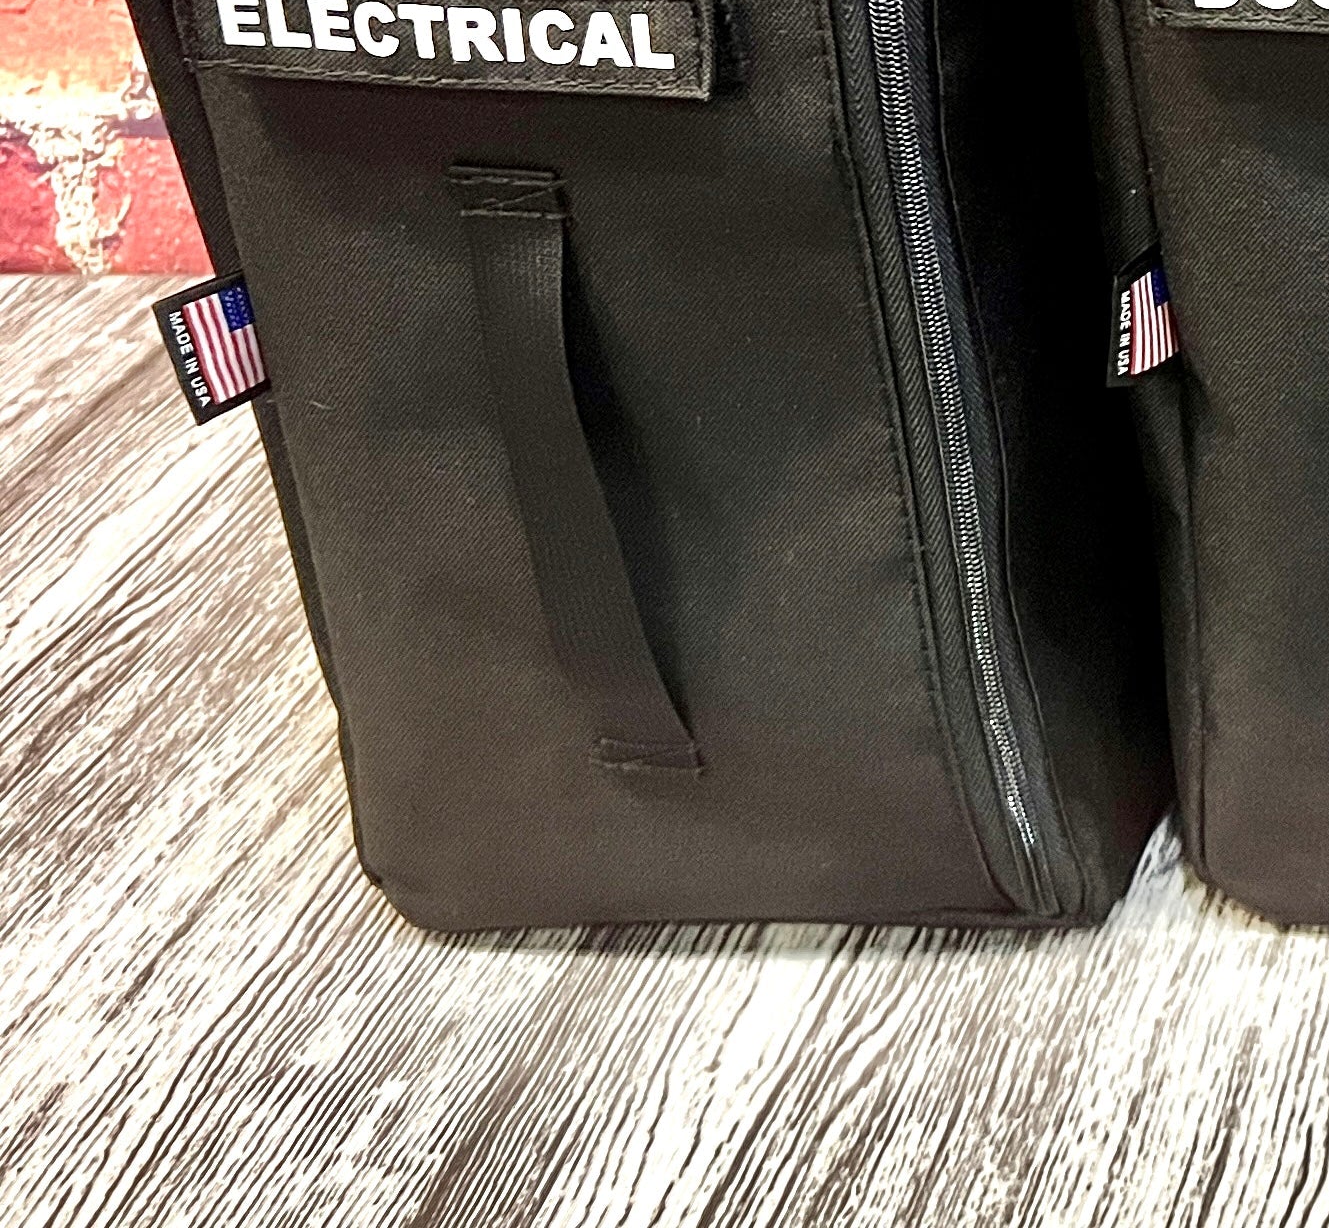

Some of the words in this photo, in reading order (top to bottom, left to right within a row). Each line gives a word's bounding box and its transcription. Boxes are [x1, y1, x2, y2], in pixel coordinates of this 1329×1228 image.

[1119, 289, 1132, 331] MADE
[168, 310, 194, 356] MADE
[1119, 332, 1131, 348] IN
[184, 357, 200, 375] IN
[1117, 348, 1131, 376] USA
[190, 376, 212, 408] USA
